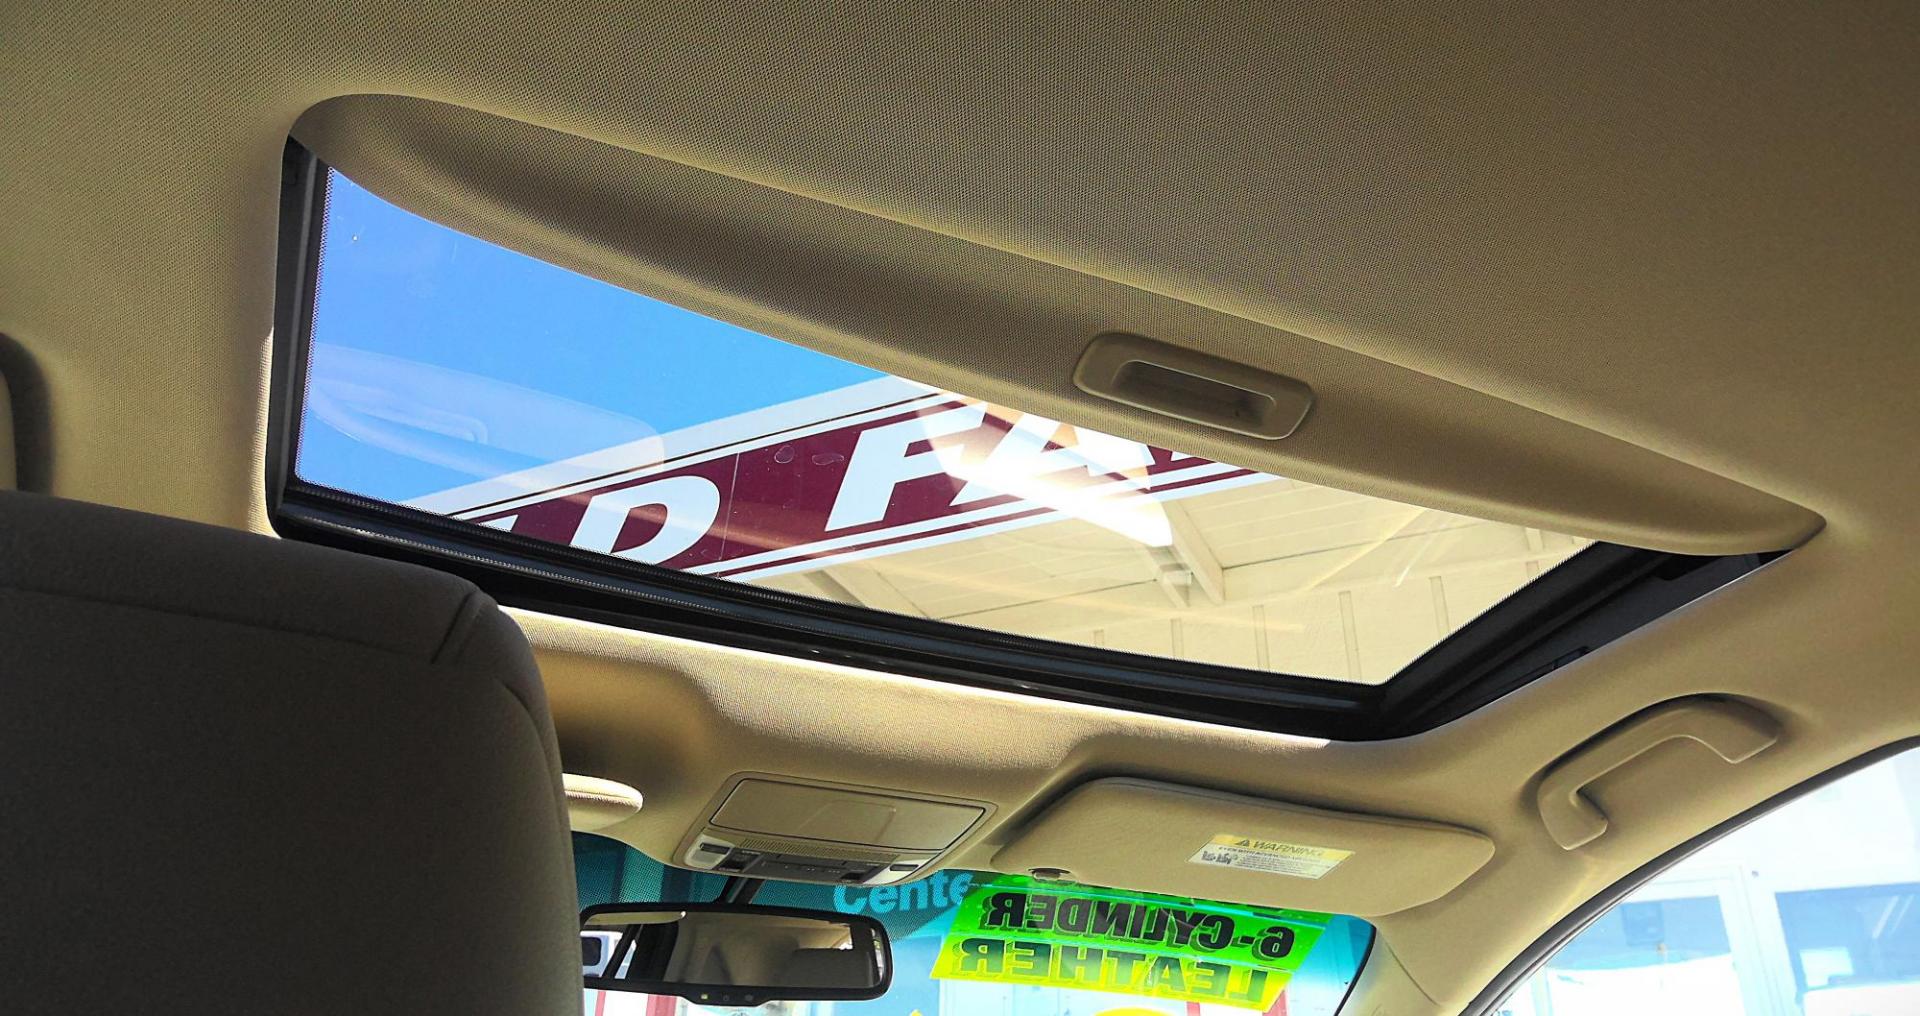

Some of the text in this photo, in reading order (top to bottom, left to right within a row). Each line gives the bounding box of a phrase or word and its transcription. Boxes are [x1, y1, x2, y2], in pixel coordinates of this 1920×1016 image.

[478, 401, 1217, 566] D FA
[1253, 841, 1325, 857] WARNING
